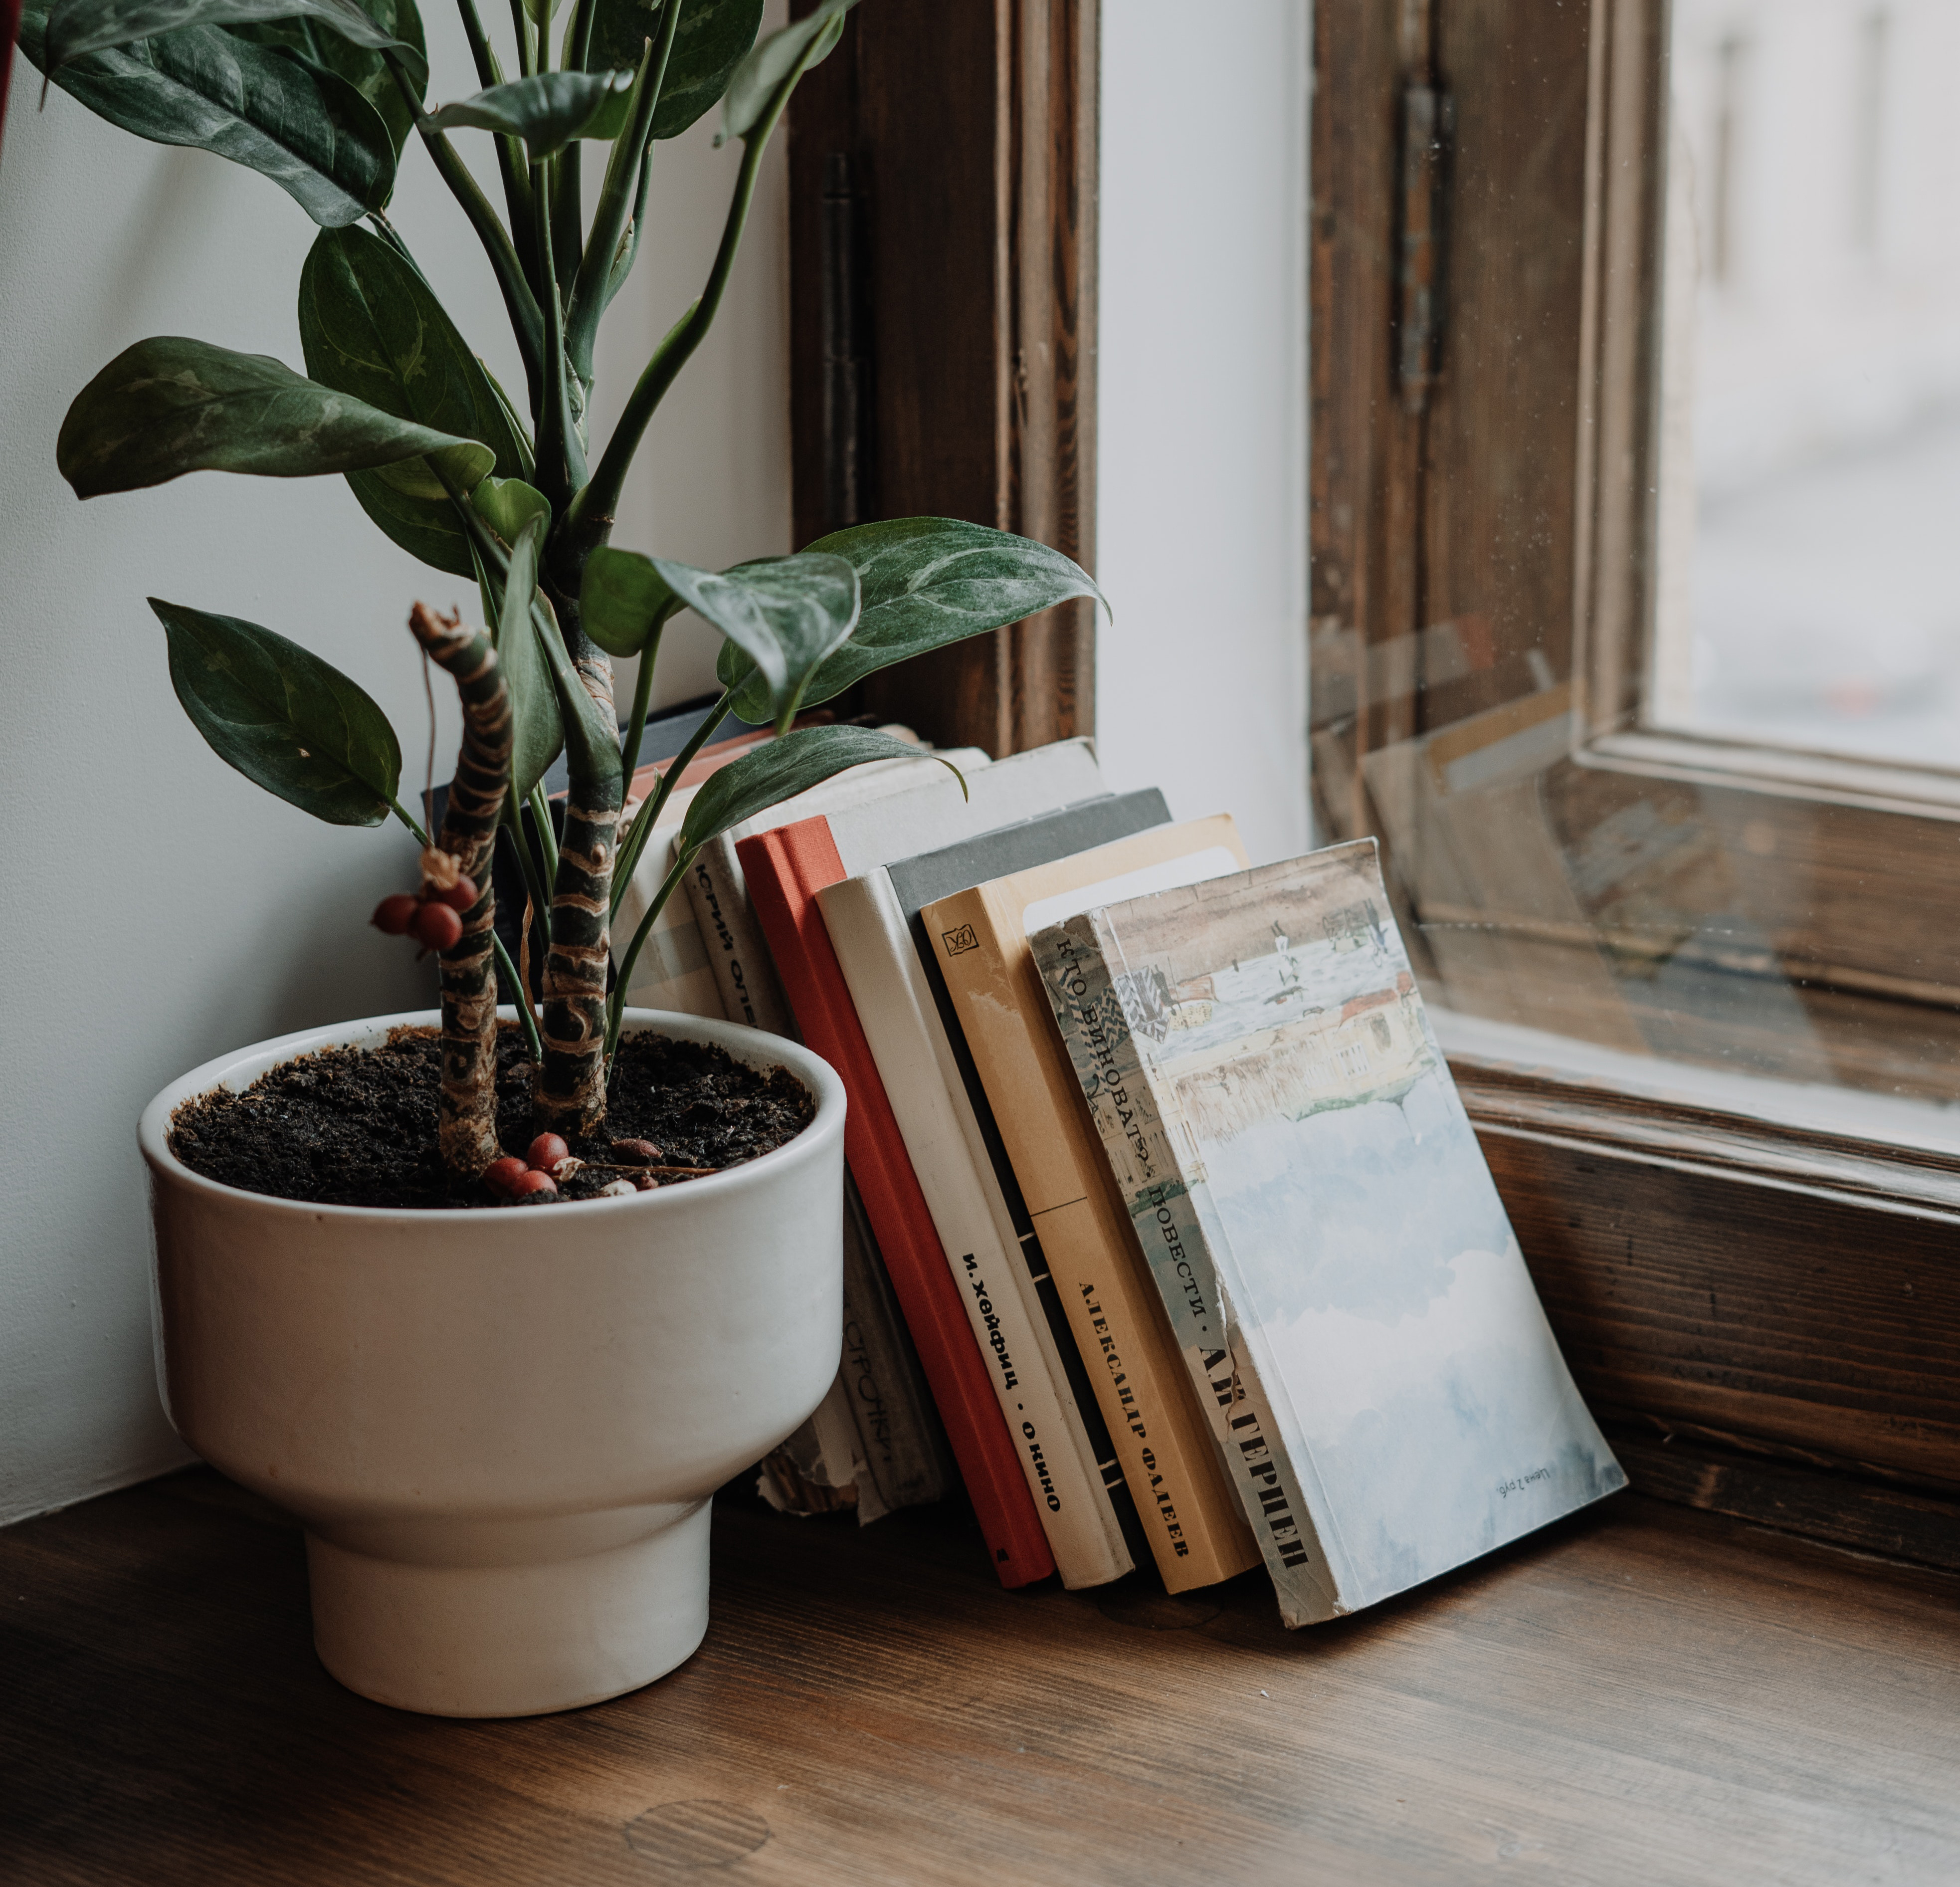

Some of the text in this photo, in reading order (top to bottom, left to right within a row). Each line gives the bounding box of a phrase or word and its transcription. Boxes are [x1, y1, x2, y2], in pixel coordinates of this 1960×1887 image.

[696, 863, 758, 1029] ЮРИЙ ОЛЕ
[1057, 938, 1087, 996] КТО
[1082, 1005, 1149, 1161] ВИНОВАТ?
[1149, 1186, 1206, 1317] ПОВЕСТИ
[1231, 1411, 1309, 1570] ГЕРЦЕН
[1079, 1281, 1189, 1558] АЛЕКСАНДР ФАДЕЕВ
[1496, 1468, 1551, 1498] Цена 2 руб.
